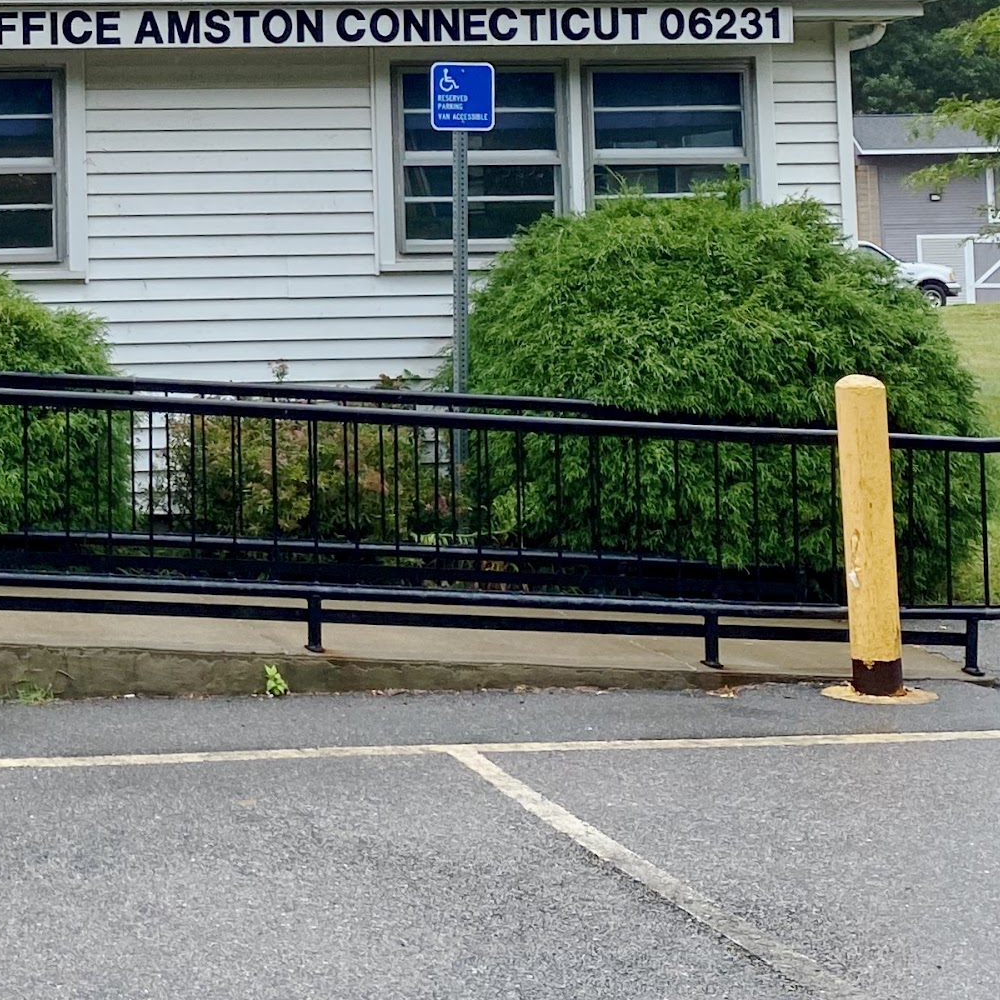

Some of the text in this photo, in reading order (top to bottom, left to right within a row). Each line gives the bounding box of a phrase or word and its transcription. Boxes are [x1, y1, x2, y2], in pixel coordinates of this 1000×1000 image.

[134, 8, 325, 45] AMSTON
[336, 6, 649, 43] CONNECTICUT
[659, 5, 782, 40] 06231
[452, 113, 488, 121] ACCESSIBLE
